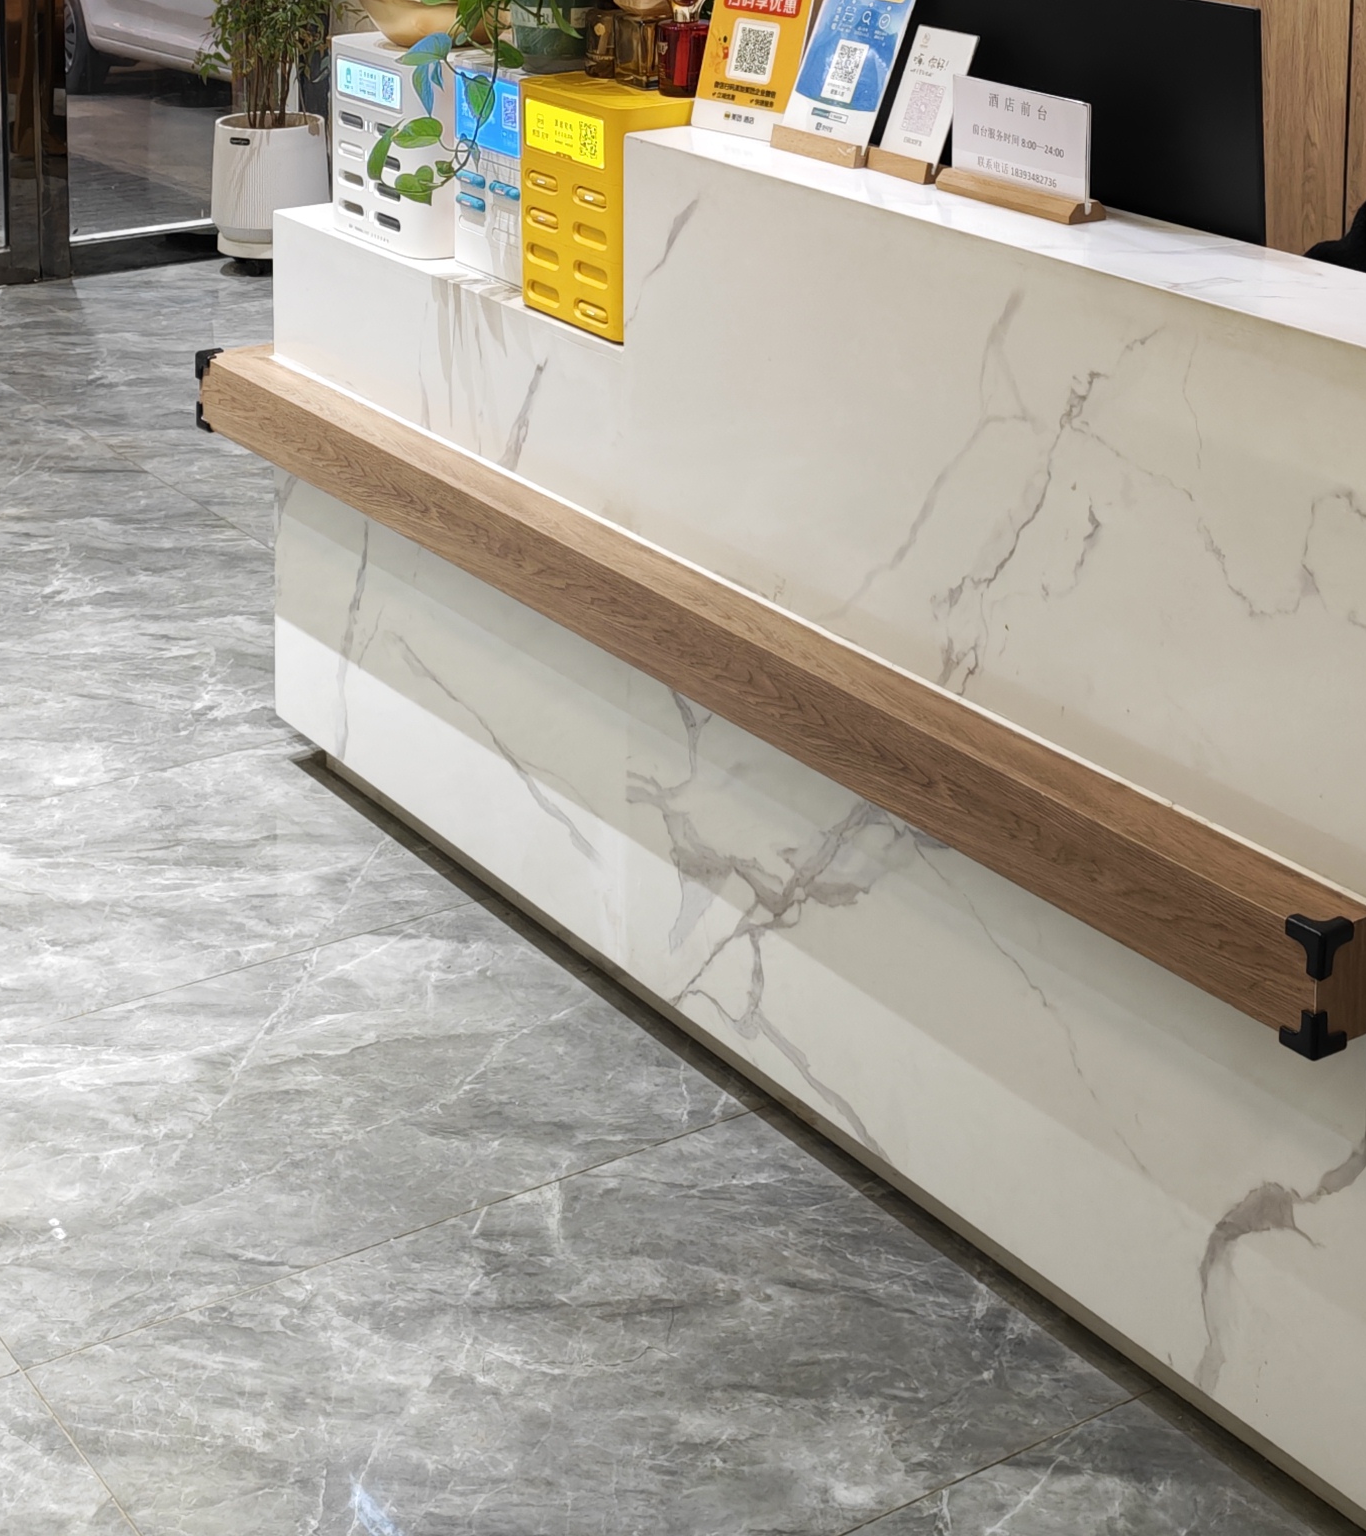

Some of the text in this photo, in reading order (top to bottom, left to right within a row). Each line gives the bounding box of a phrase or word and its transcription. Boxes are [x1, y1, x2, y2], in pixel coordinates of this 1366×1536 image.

[988, 92, 1049, 121] 酒店前台
[743, 115, 755, 125] 酒店
[972, 123, 1020, 148] 前台服务时间
[977, 156, 1009, 176] 联系电话
